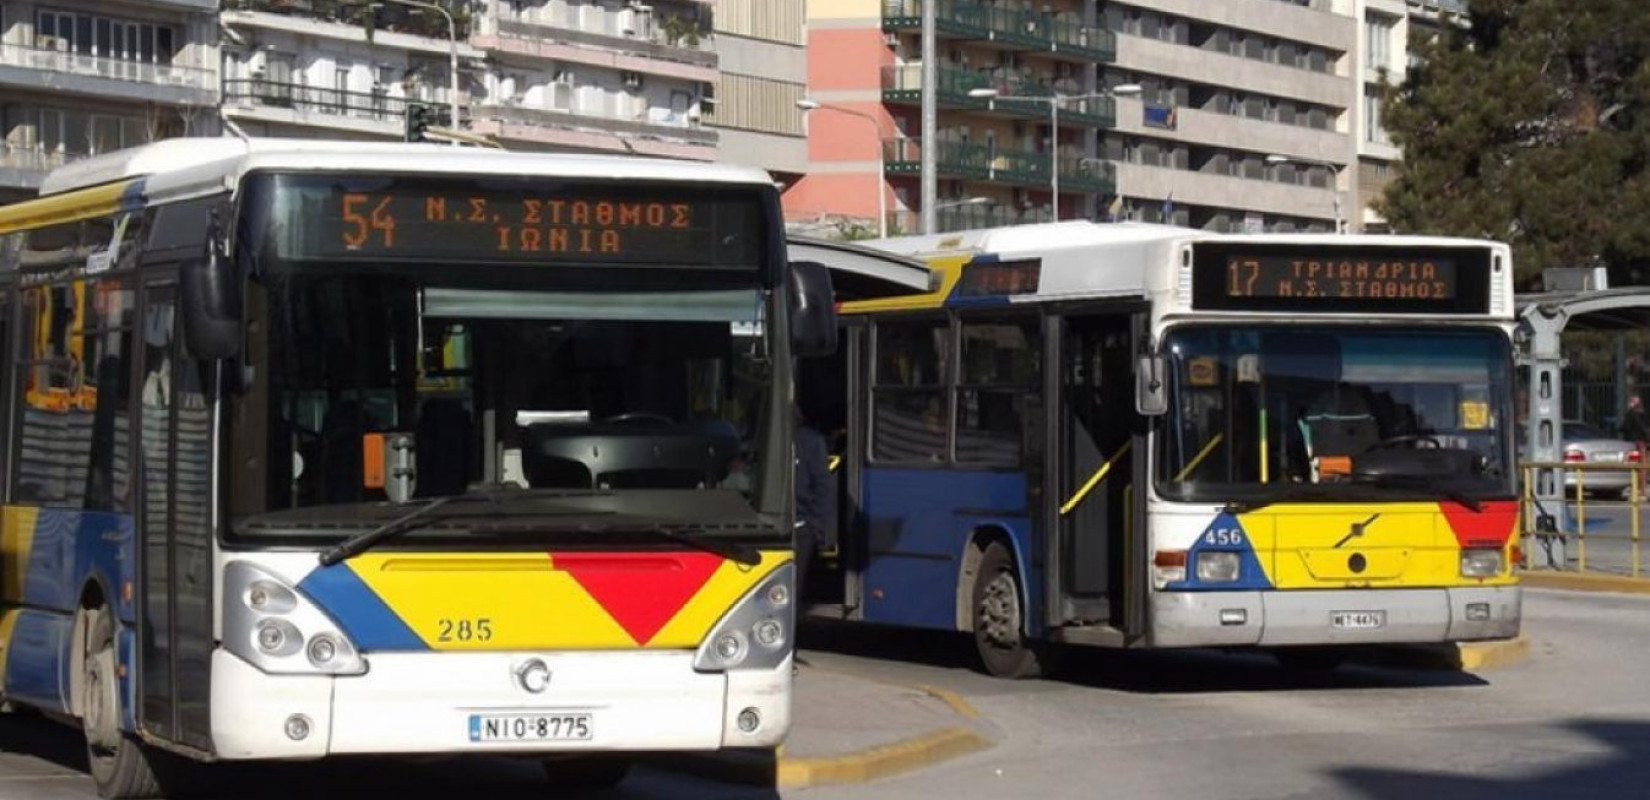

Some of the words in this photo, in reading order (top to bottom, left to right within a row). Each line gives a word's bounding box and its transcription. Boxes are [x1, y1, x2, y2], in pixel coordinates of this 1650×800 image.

[342, 194, 395, 249] 54
[522, 199, 690, 228] ΣΤΑΘΜΟΣ
[497, 226, 621, 252] ΙΩΝΙΑ
[1228, 261, 1258, 296] 17
[1293, 261, 1434, 279] ΤΡΙΑΝΔΡΙΑ
[1341, 280, 1446, 298] ΣΤΑΘΜΟΣ
[1205, 529, 1241, 545] 456
[437, 618, 492, 642] 285
